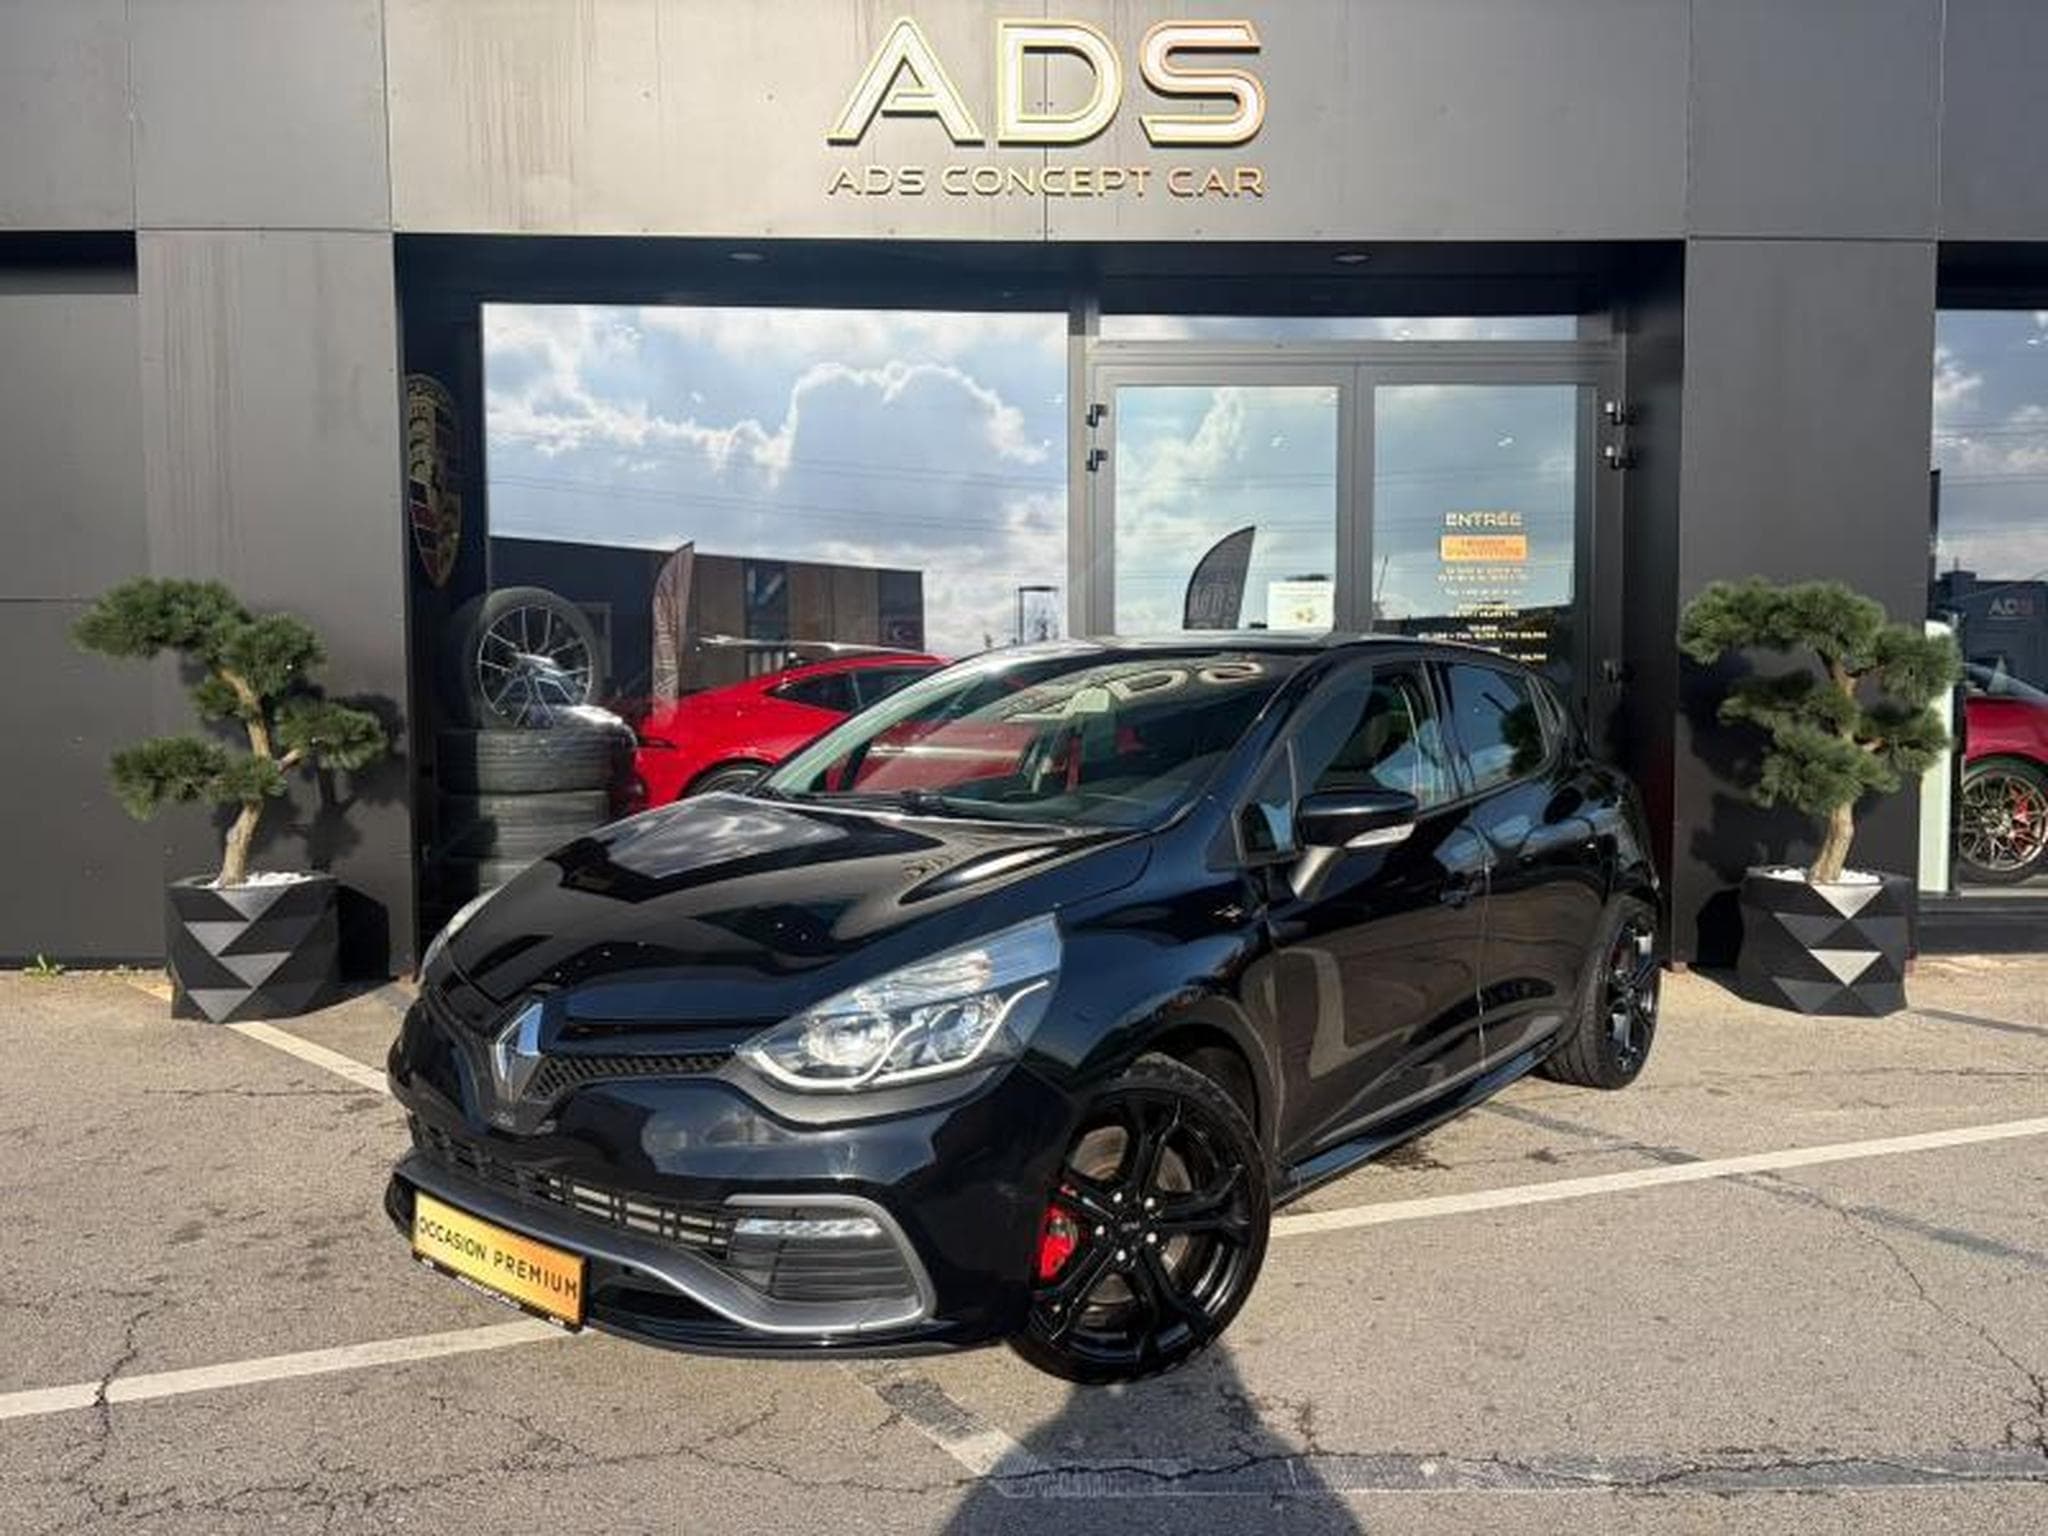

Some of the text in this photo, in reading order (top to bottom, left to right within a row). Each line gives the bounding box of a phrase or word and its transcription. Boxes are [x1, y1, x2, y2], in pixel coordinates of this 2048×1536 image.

[827, 15, 1267, 147] ADS
[828, 166, 1264, 197] ADS CONCEPT CAR
[418, 1215, 488, 1262] OCCASION
[493, 1251, 578, 1300] PREMIUM
